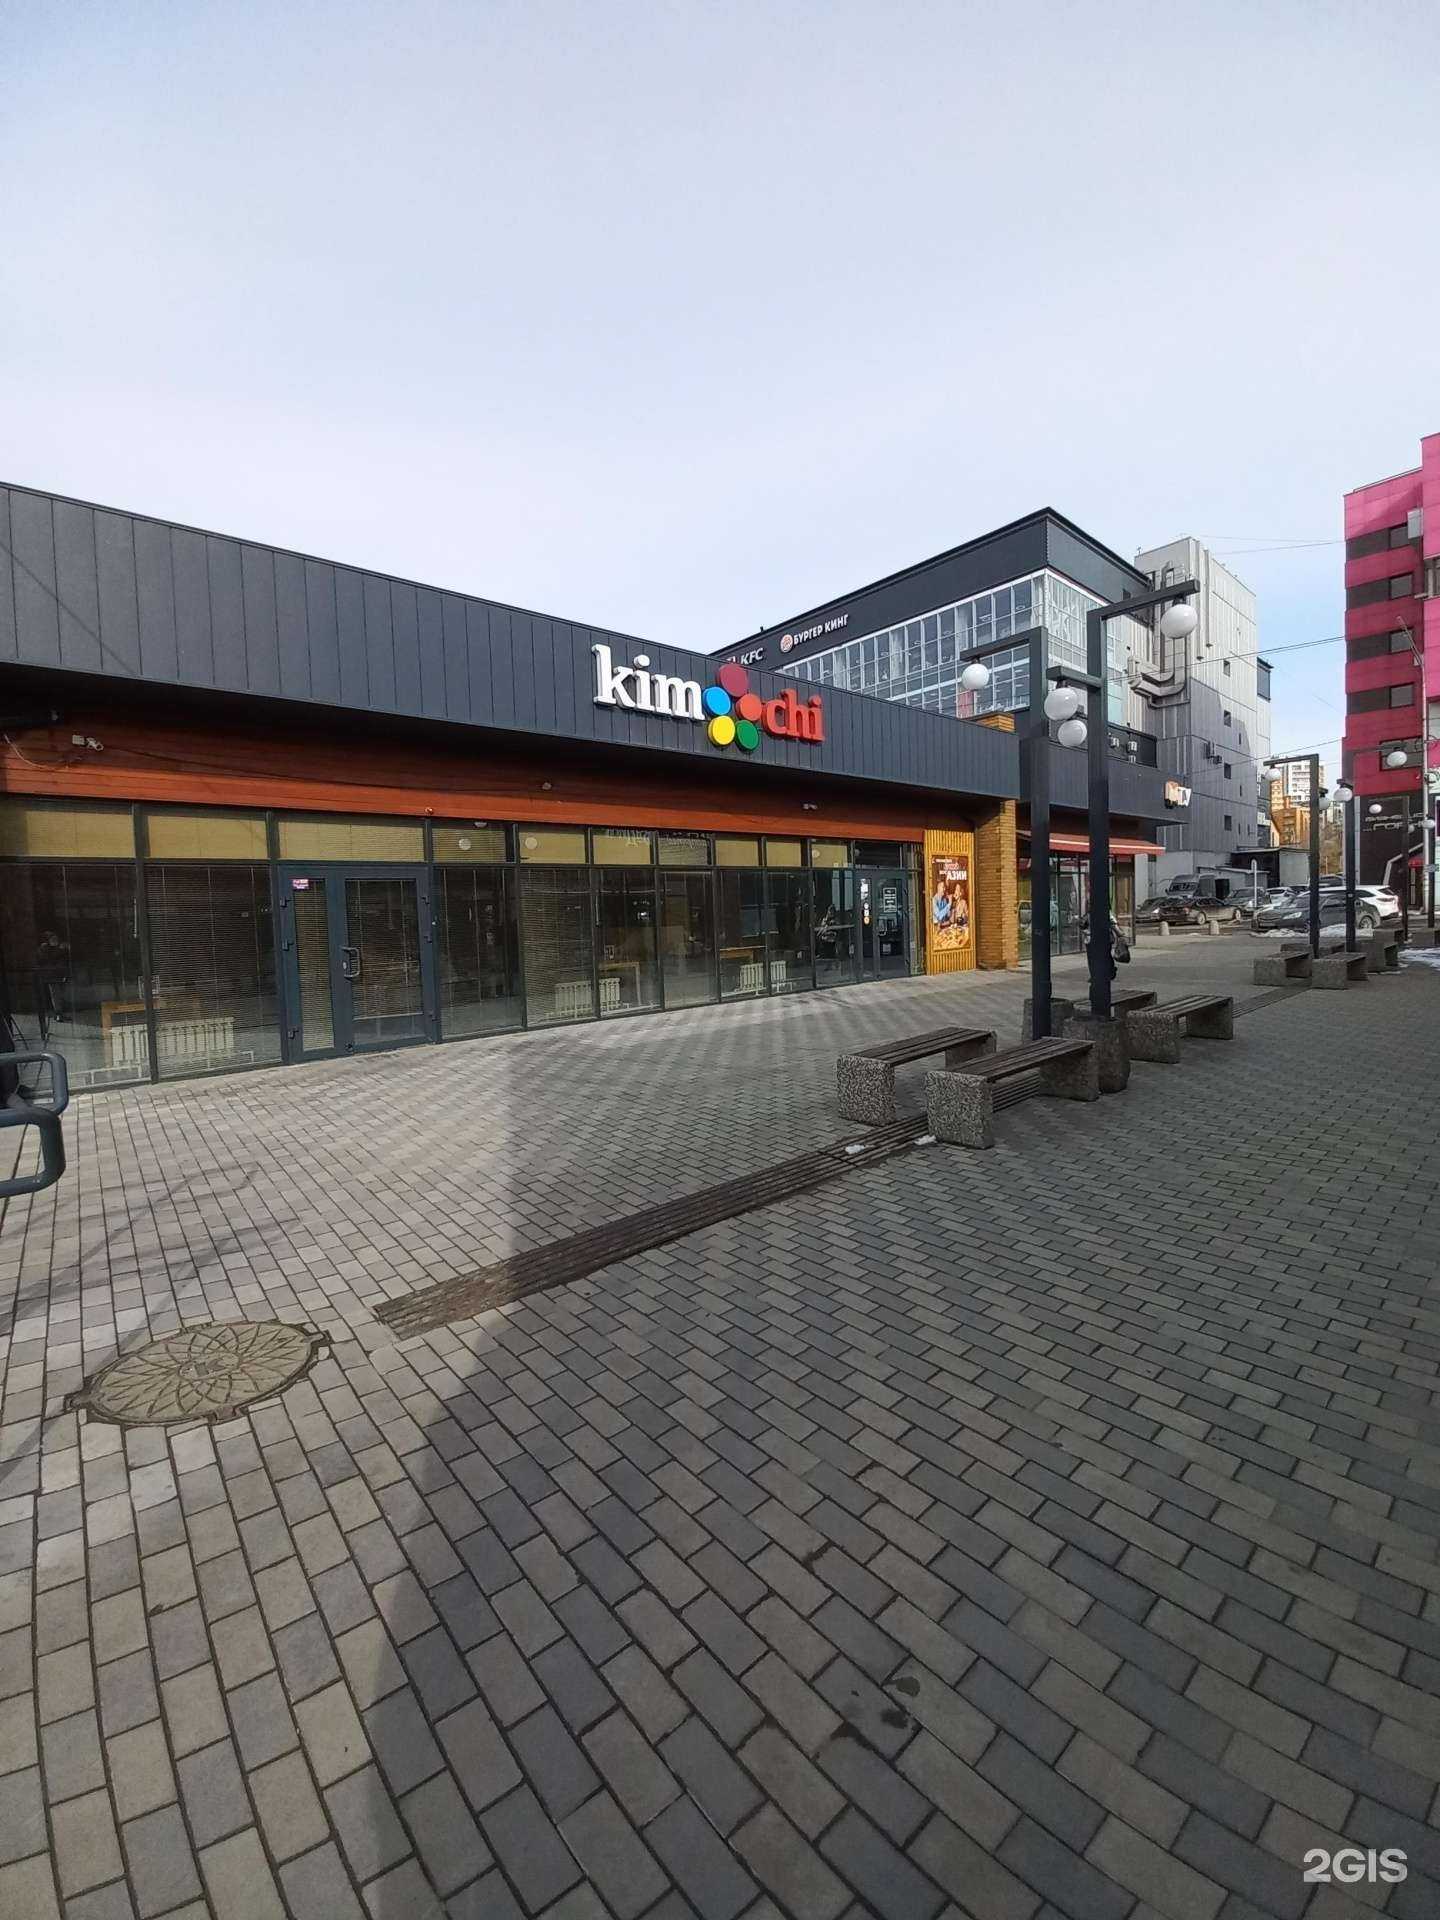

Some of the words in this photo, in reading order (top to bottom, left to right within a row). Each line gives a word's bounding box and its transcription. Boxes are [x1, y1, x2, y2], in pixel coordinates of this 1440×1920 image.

[793, 625, 824, 645] БУРГЕР
[824, 614, 849, 633] КИНГ
[740, 647, 764, 665] KFC
